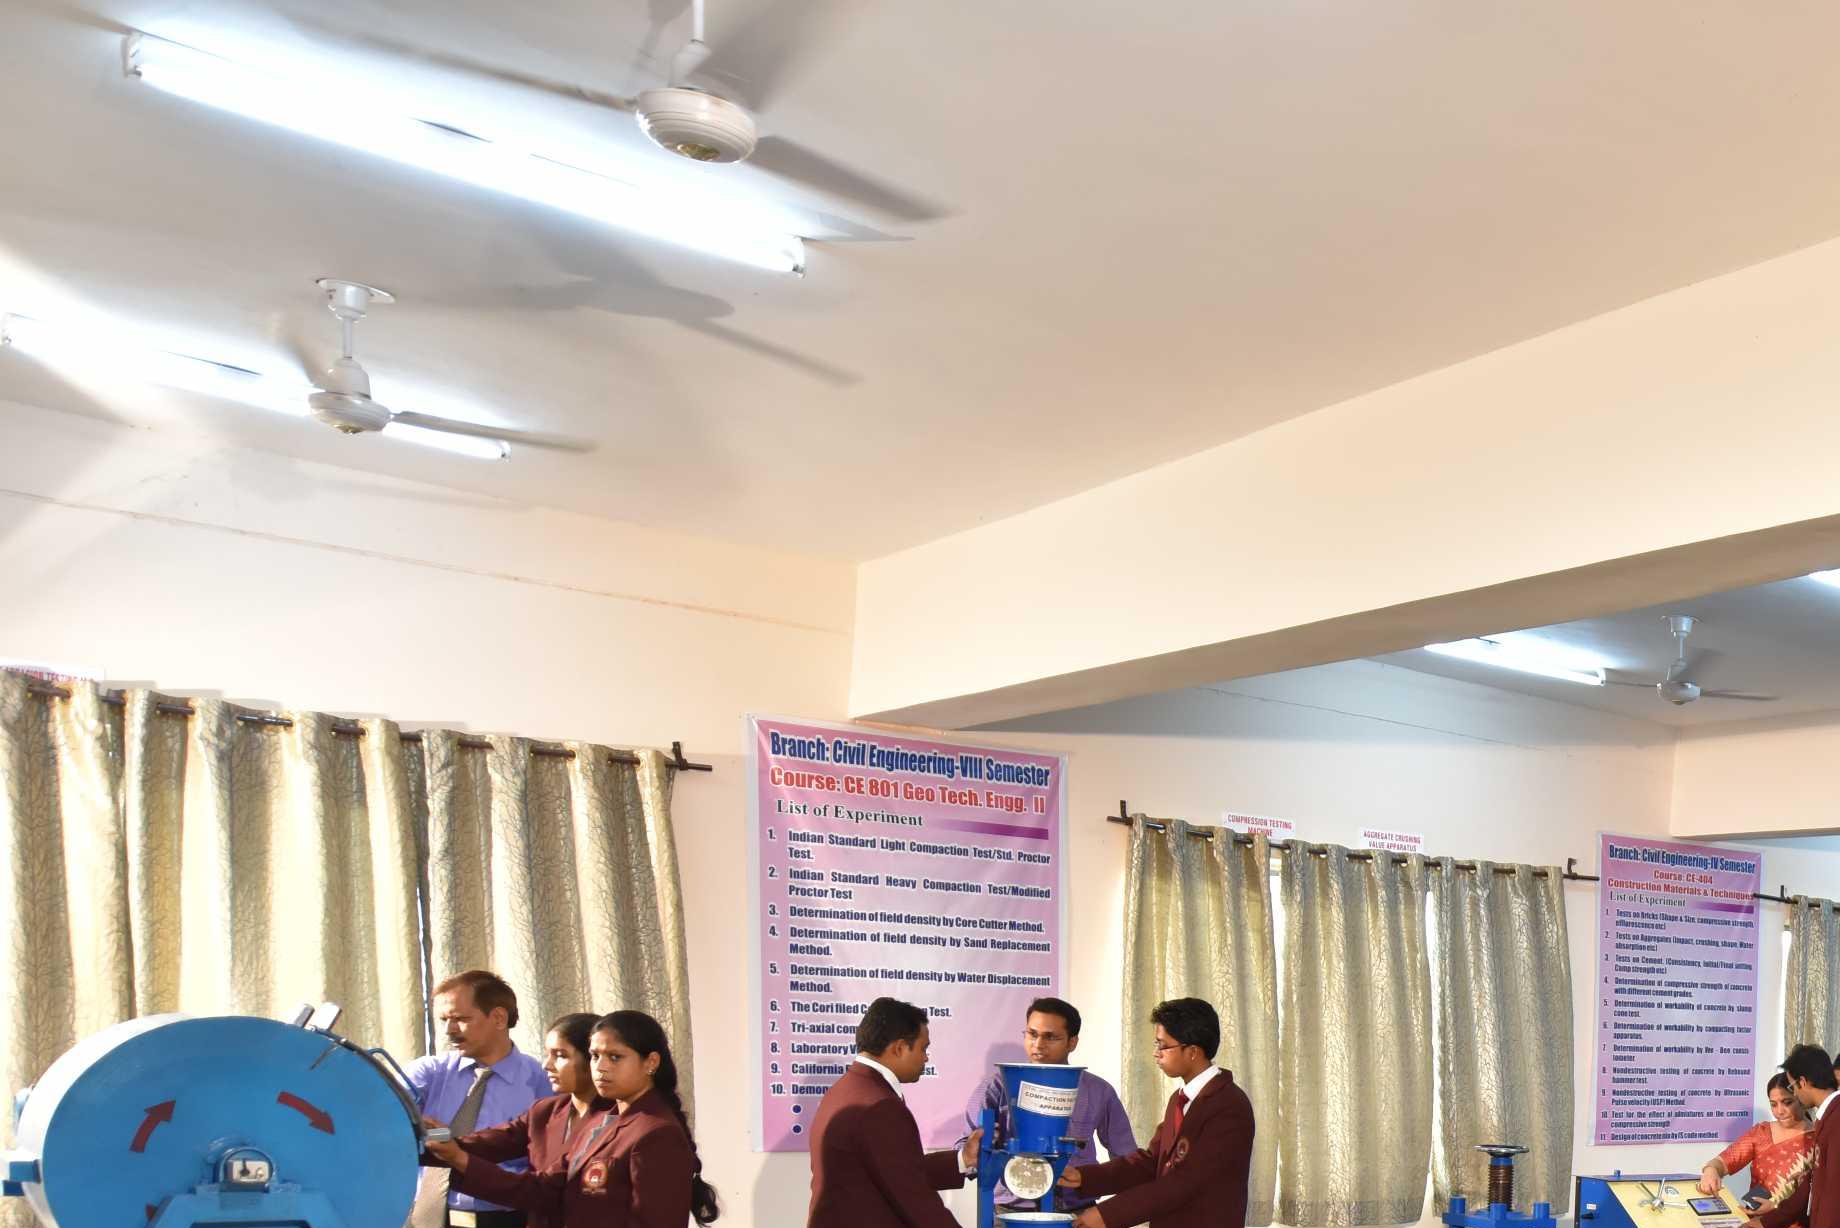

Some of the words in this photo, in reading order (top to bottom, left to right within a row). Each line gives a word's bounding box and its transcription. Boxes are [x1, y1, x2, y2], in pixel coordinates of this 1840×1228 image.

[770, 732, 829, 761] Branch:
[833, 740, 866, 766] Civil
[869, 745, 982, 779] Engineering-VIII
[986, 758, 1050, 786] Semester
[770, 768, 840, 792] Course:
[844, 776, 864, 794] CE
[868, 778, 898, 798] 801
[904, 783, 934, 802] Geo
[939, 786, 982, 807] Tech.
[986, 792, 1027, 812] Engg.
[1034, 796, 1044, 813] II
[777, 799, 808, 815] List
[814, 804, 829, 816] of
[834, 805, 922, 826] Experiment
[1228, 814, 1268, 826] COMPRESSION
[1270, 819, 1292, 829] TESTING
[1364, 830, 1394, 841] AGGREGATE
[1396, 834, 1421, 844] CRUSHING
[768, 829, 776, 840] 1.
[788, 831, 824, 844] Indian
[828, 834, 876, 848] Standard
[880, 839, 905, 852] Light
[910, 842, 968, 856] Compaction
[973, 848, 1014, 860] Test/Std.
[1018, 852, 1050, 864] Proctor
[788, 847, 814, 860] Test.
[1386, 844, 1417, 852] APPARATUS
[1610, 844, 1640, 860] Branch:
[1642, 848, 1659, 863] Civil
[1662, 851, 1718, 870] Engineering-IV
[1720, 858, 1756, 874] Semester
[768, 866, 778, 878] 2.
[789, 868, 824, 880] Indian
[831, 872, 879, 886] Standard
[886, 876, 916, 889] Heavy
[923, 878, 981, 893] Compaction
[988, 884, 1050, 898] Test/Modified
[1654, 870, 1684, 882] Course:
[789, 886, 828, 898] Proctor
[830, 888, 852, 899] Test
[1608, 878, 1662, 892] Construction
[1664, 884, 1702, 896] Materials
[1610, 890, 1626, 900] List
[1628, 893, 1637, 902] of
[1640, 894, 1686, 906] Experiment
[769, 904, 778, 916] 3.
[790, 906, 866, 922] Determination
[868, 911, 878, 922] of
[880, 912, 902, 923] field
[904, 914, 941, 926] density
[943, 916, 954, 928] by
[955, 917, 977, 928] Core
[978, 918, 1007, 930] Cutter
[1008, 920, 1044, 932] Method.
[769, 926, 778, 936] 4.
[790, 926, 866, 942] Determination
[870, 932, 880, 942] of
[884, 932, 906, 944] field
[910, 934, 946, 947] density
[950, 937, 961, 948] by
[964, 937, 988, 949] Sand
[990, 939, 1050, 952] Replacement
[790, 943, 832, 956] Method.
[770, 963, 780, 974] 5.
[790, 964, 866, 978] Determination
[868, 968, 879, 979] of
[880, 969, 904, 980] field
[906, 970, 942, 982] density
[944, 972, 956, 982] by
[957, 972, 986, 984] Water
[988, 974, 1050, 986] Displacement
[790, 980, 832, 992] Method.
[770, 1001, 780, 1012] 6.
[791, 1002, 810, 1012] The
[812, 1002, 834, 1013] Cori
[835, 1003, 858, 1014] filed
[930, 1006, 952, 1017] Test.
[770, 1022, 778, 1032] 7.
[791, 1022, 834, 1034] Tri-axial
[771, 1042, 780, 1053] 8.
[792, 1043, 848, 1055] Laboratory
[771, 1064, 780, 1074] 9.
[792, 1064, 844, 1074] California
[772, 1084, 786, 1094] 10.
[1024, 1091, 1066, 1102] COMPACTION
